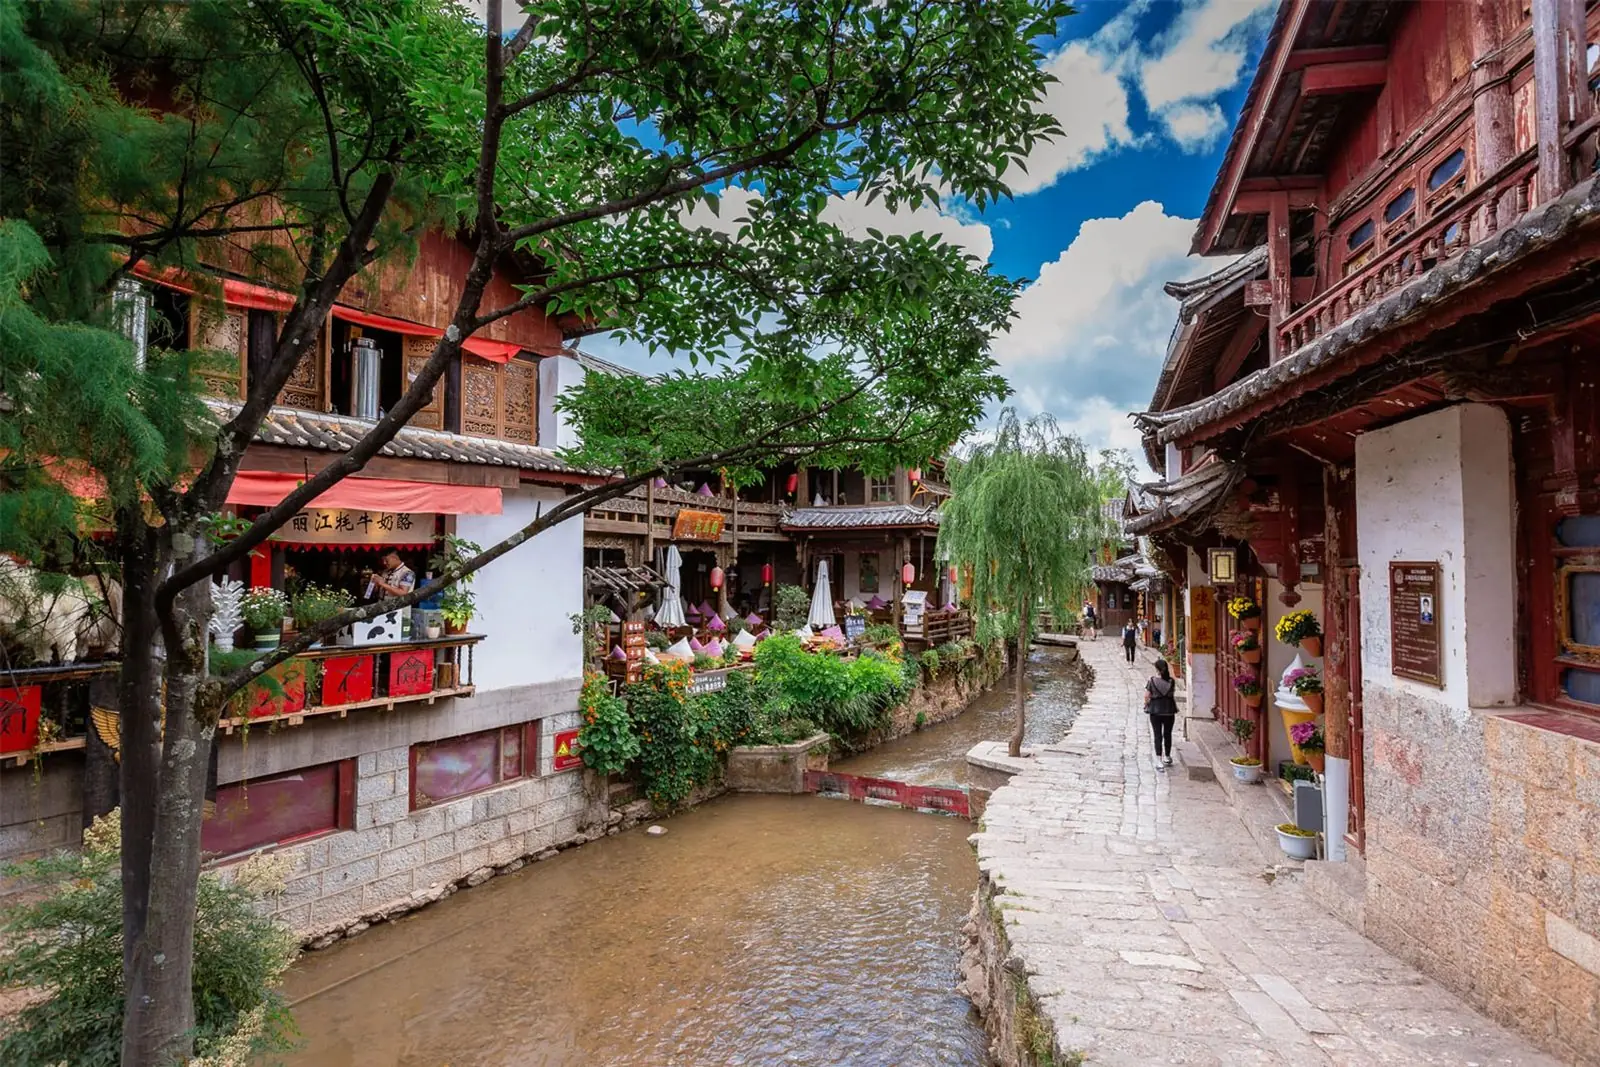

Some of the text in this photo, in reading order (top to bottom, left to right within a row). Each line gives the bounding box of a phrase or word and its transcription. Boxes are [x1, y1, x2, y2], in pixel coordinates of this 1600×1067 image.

[292, 511, 413, 534] 丽江牦牛奶酪
